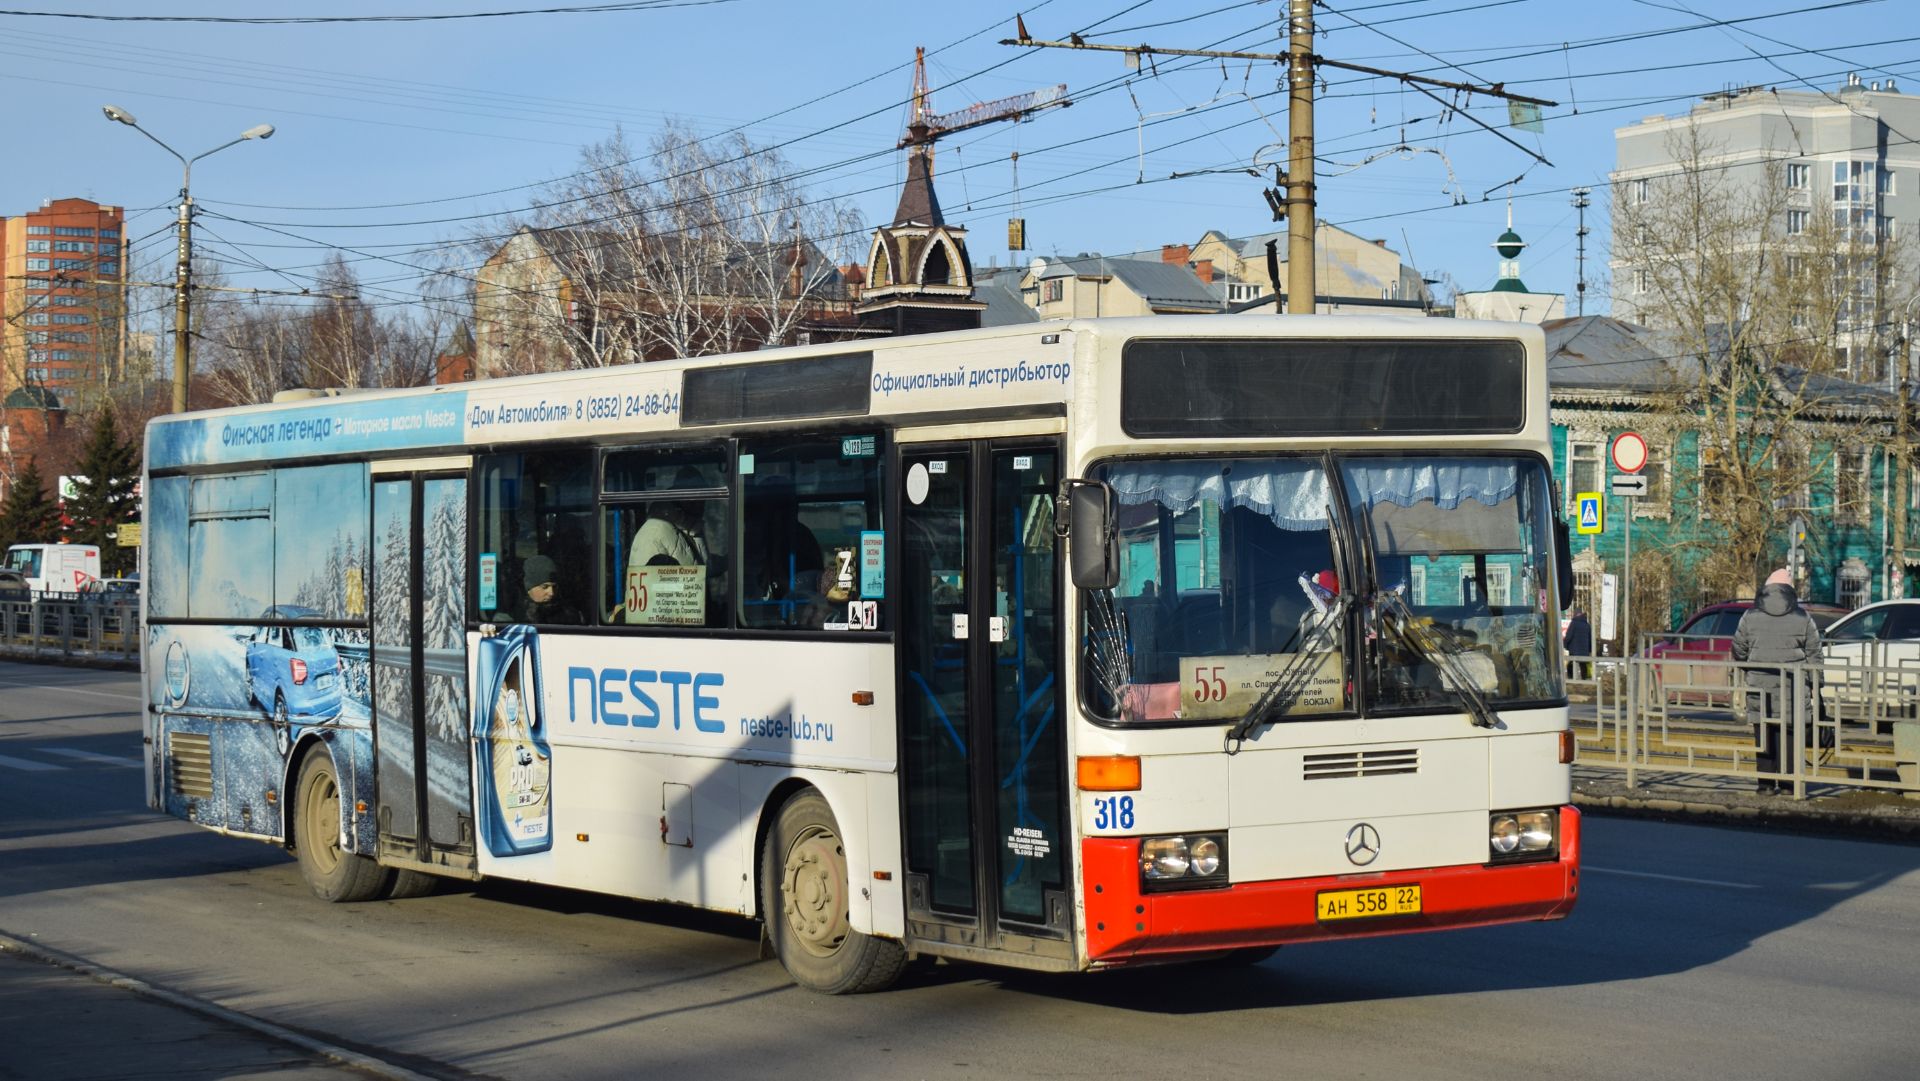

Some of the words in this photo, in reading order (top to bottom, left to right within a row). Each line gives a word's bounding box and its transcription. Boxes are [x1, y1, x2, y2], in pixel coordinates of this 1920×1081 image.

[873, 366, 965, 397] Официальный
[969, 360, 1070, 389] дистрибьютор
[222, 423, 275, 447] Финская
[278, 417, 331, 442] легенда
[343, 416, 389, 438] Моторное
[391, 414, 422, 431] масло
[425, 409, 456, 428] Neste
[467, 405, 494, 428] «Дом
[498, 400, 573, 424] Автомобиля»
[575, 400, 583, 419] 8
[586, 394, 622, 421] (3852)
[628, 572, 648, 613] 55
[568, 666, 725, 734] NESTE
[1194, 666, 1227, 703] 55
[1303, 697, 1335, 706] ВОКЗАЛ
[740, 713, 834, 742] neste-lub.ru
[510, 765, 535, 793] PRO
[523, 822, 544, 834] NESTE
[1094, 795, 1135, 830] 318
[1356, 892, 1388, 913] 558
[1398, 888, 1414, 904] 22
